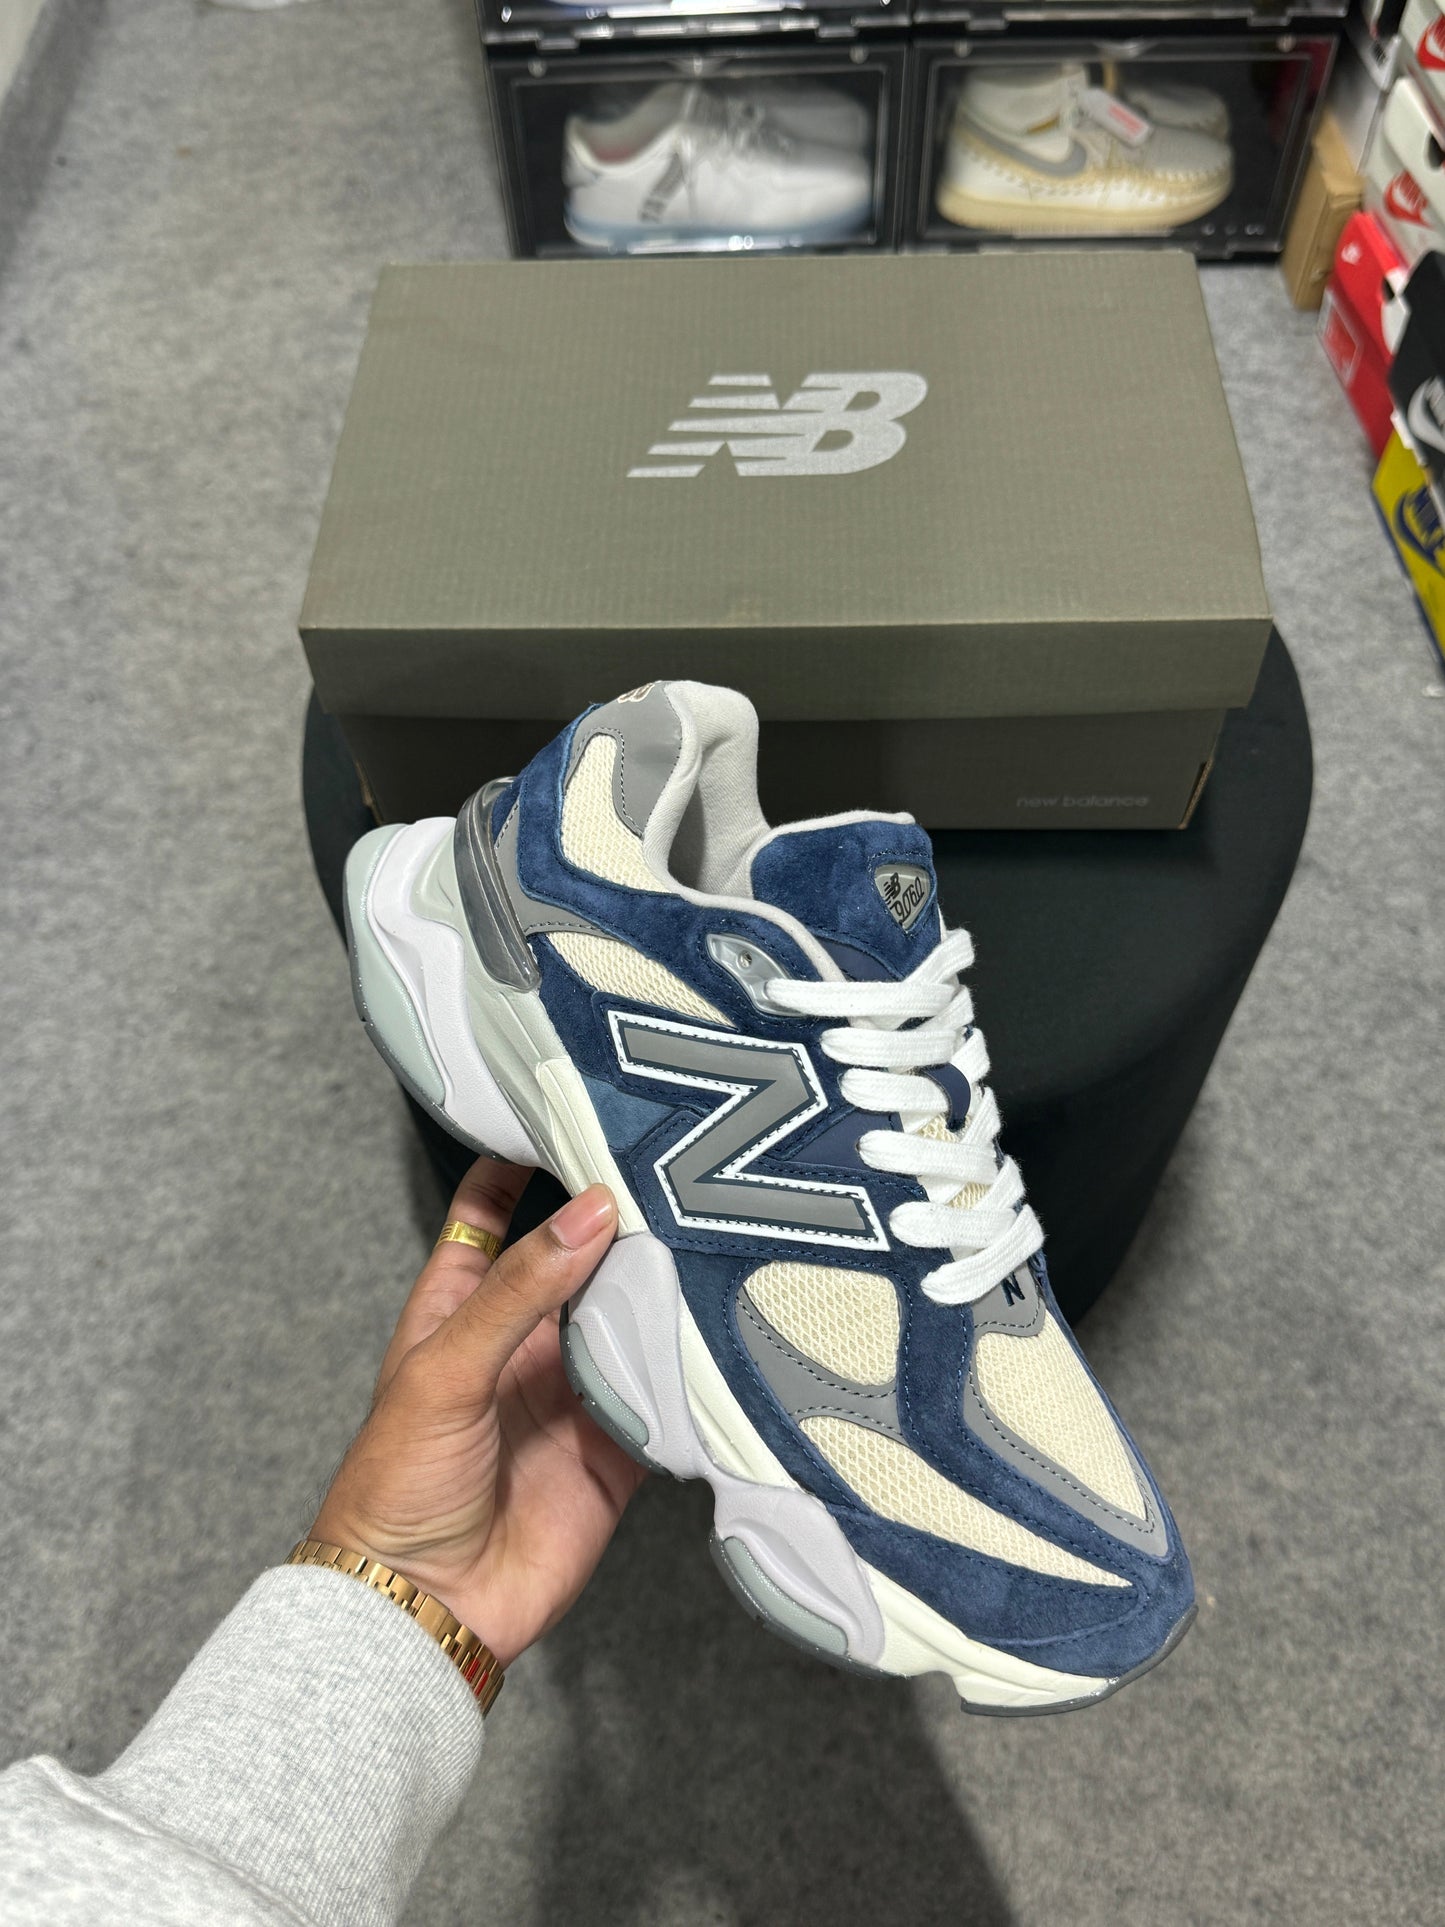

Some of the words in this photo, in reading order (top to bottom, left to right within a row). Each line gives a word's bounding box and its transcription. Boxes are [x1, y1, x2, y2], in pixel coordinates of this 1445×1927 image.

[626, 371, 929, 478] NB
[1016, 796, 1058, 808] new
[1062, 793, 1149, 808] balance
[889, 876, 925, 926] 9060
[607, 1009, 891, 1252] N
